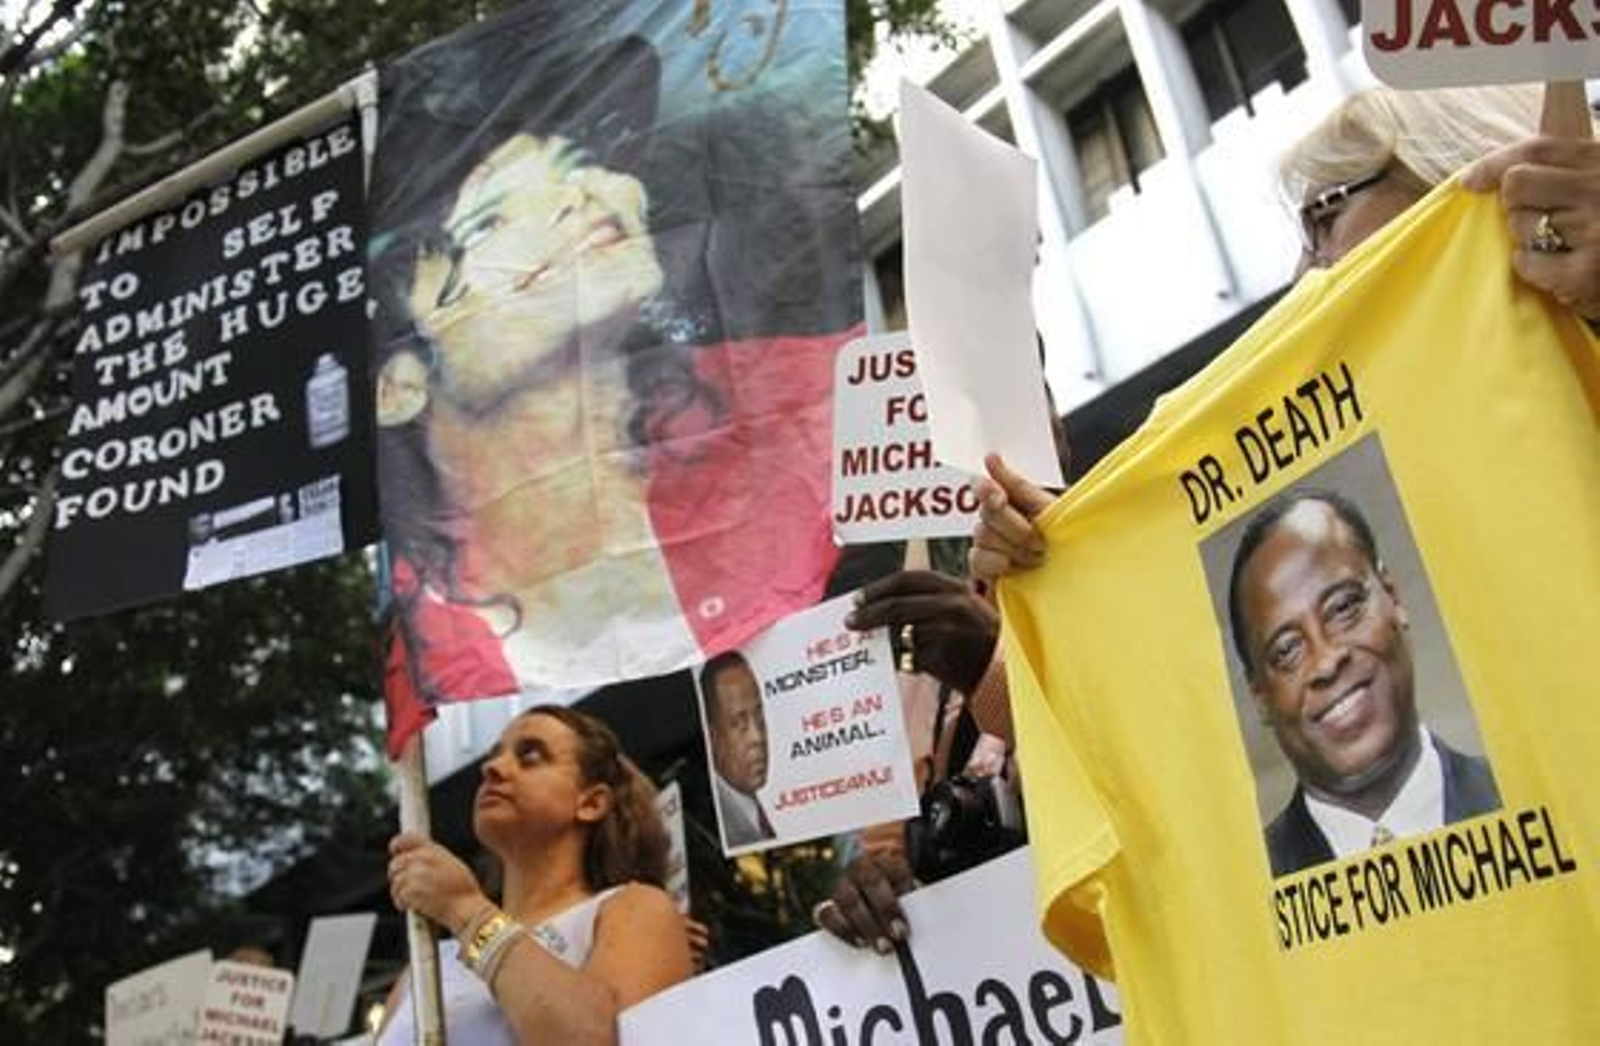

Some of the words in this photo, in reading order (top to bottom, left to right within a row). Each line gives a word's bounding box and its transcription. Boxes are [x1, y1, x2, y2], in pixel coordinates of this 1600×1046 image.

[1370, 0, 1600, 51] JACK
[96, 127, 356, 263] IMPOSSIBLE
[75, 226, 355, 352] ADMINISTER
[80, 272, 138, 311] TO
[95, 330, 188, 386] THE
[220, 267, 365, 342] HUGE
[848, 350, 916, 386] JUS
[67, 353, 232, 437] AMOUNT
[886, 393, 928, 425] FO
[61, 392, 281, 480] CORONER
[1179, 454, 1243, 524] DR.
[1235, 362, 1363, 485] DEATH
[841, 440, 942, 478] MICH
[54, 460, 225, 529] FOUND
[835, 484, 981, 523] JACKSO
[851, 694, 883, 719] AN
[1275, 872, 1350, 950] STICE
[1346, 853, 1410, 930] FOR
[1407, 807, 1577, 912] MICHAEL
[215, 967, 288, 994] JUSTICE
[230, 990, 265, 1009] FOR
[205, 1006, 278, 1035] MICHAEL
